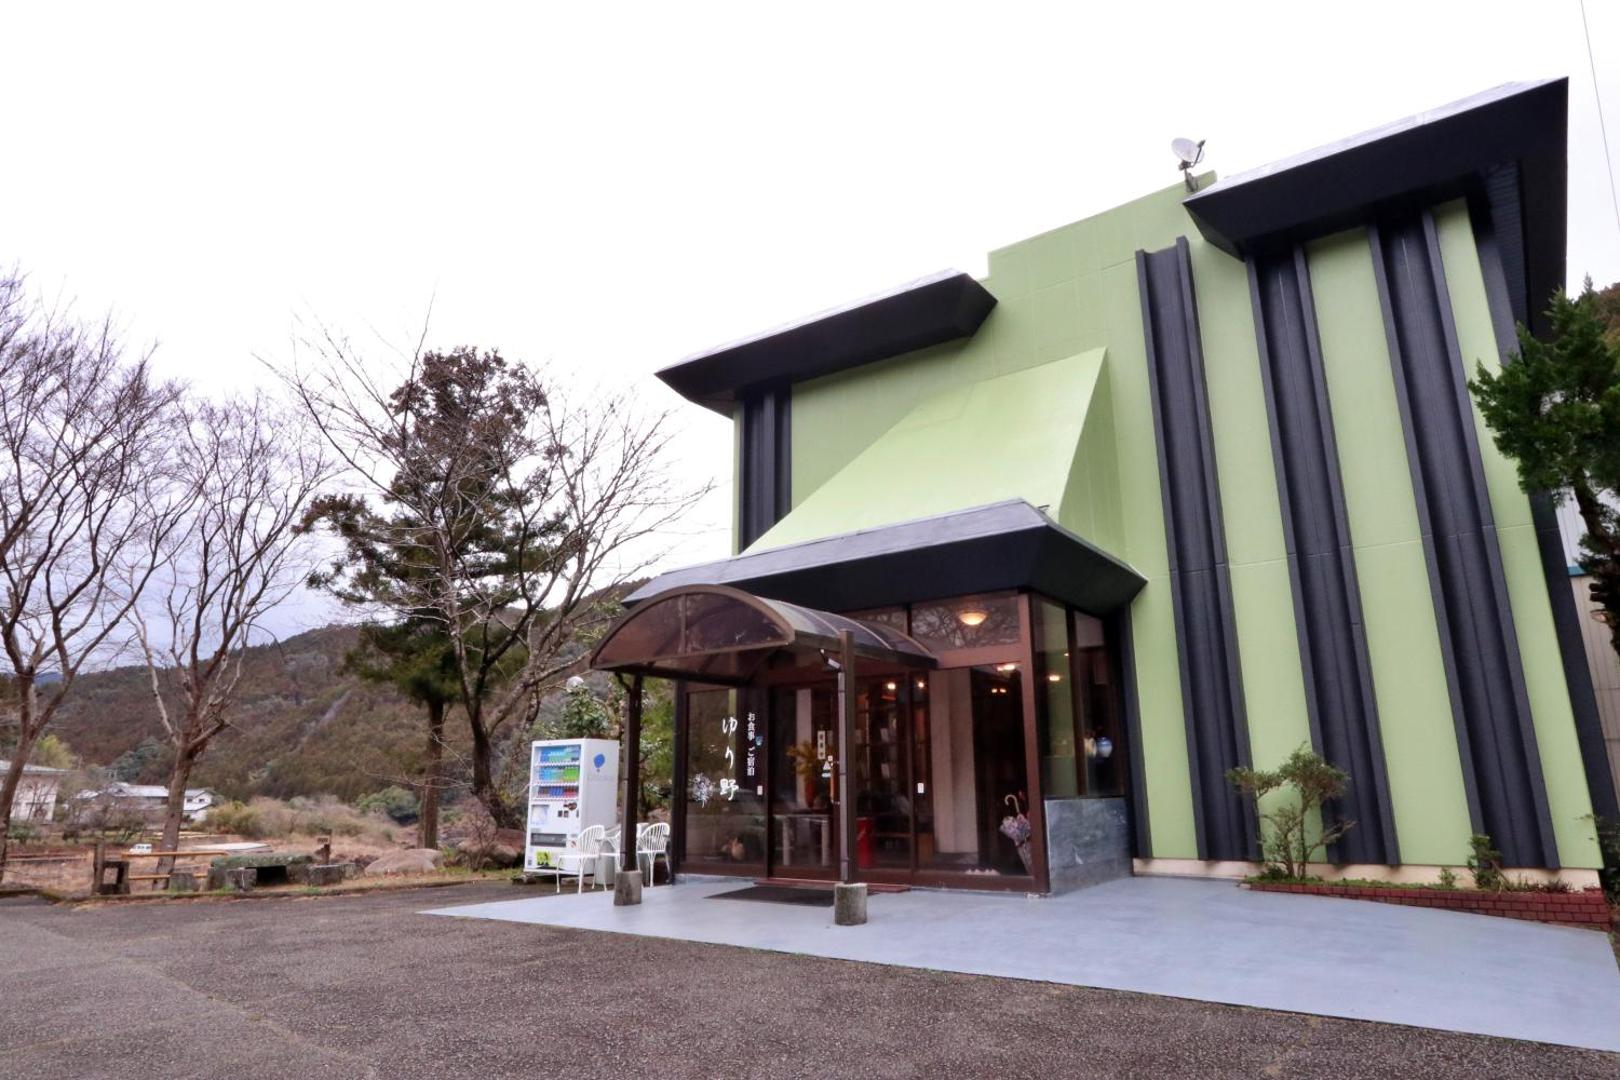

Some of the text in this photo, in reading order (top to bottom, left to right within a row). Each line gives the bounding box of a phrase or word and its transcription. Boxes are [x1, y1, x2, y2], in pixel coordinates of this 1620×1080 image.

[747, 712, 756, 741] お食事
[719, 716, 739, 801] ゆり野
